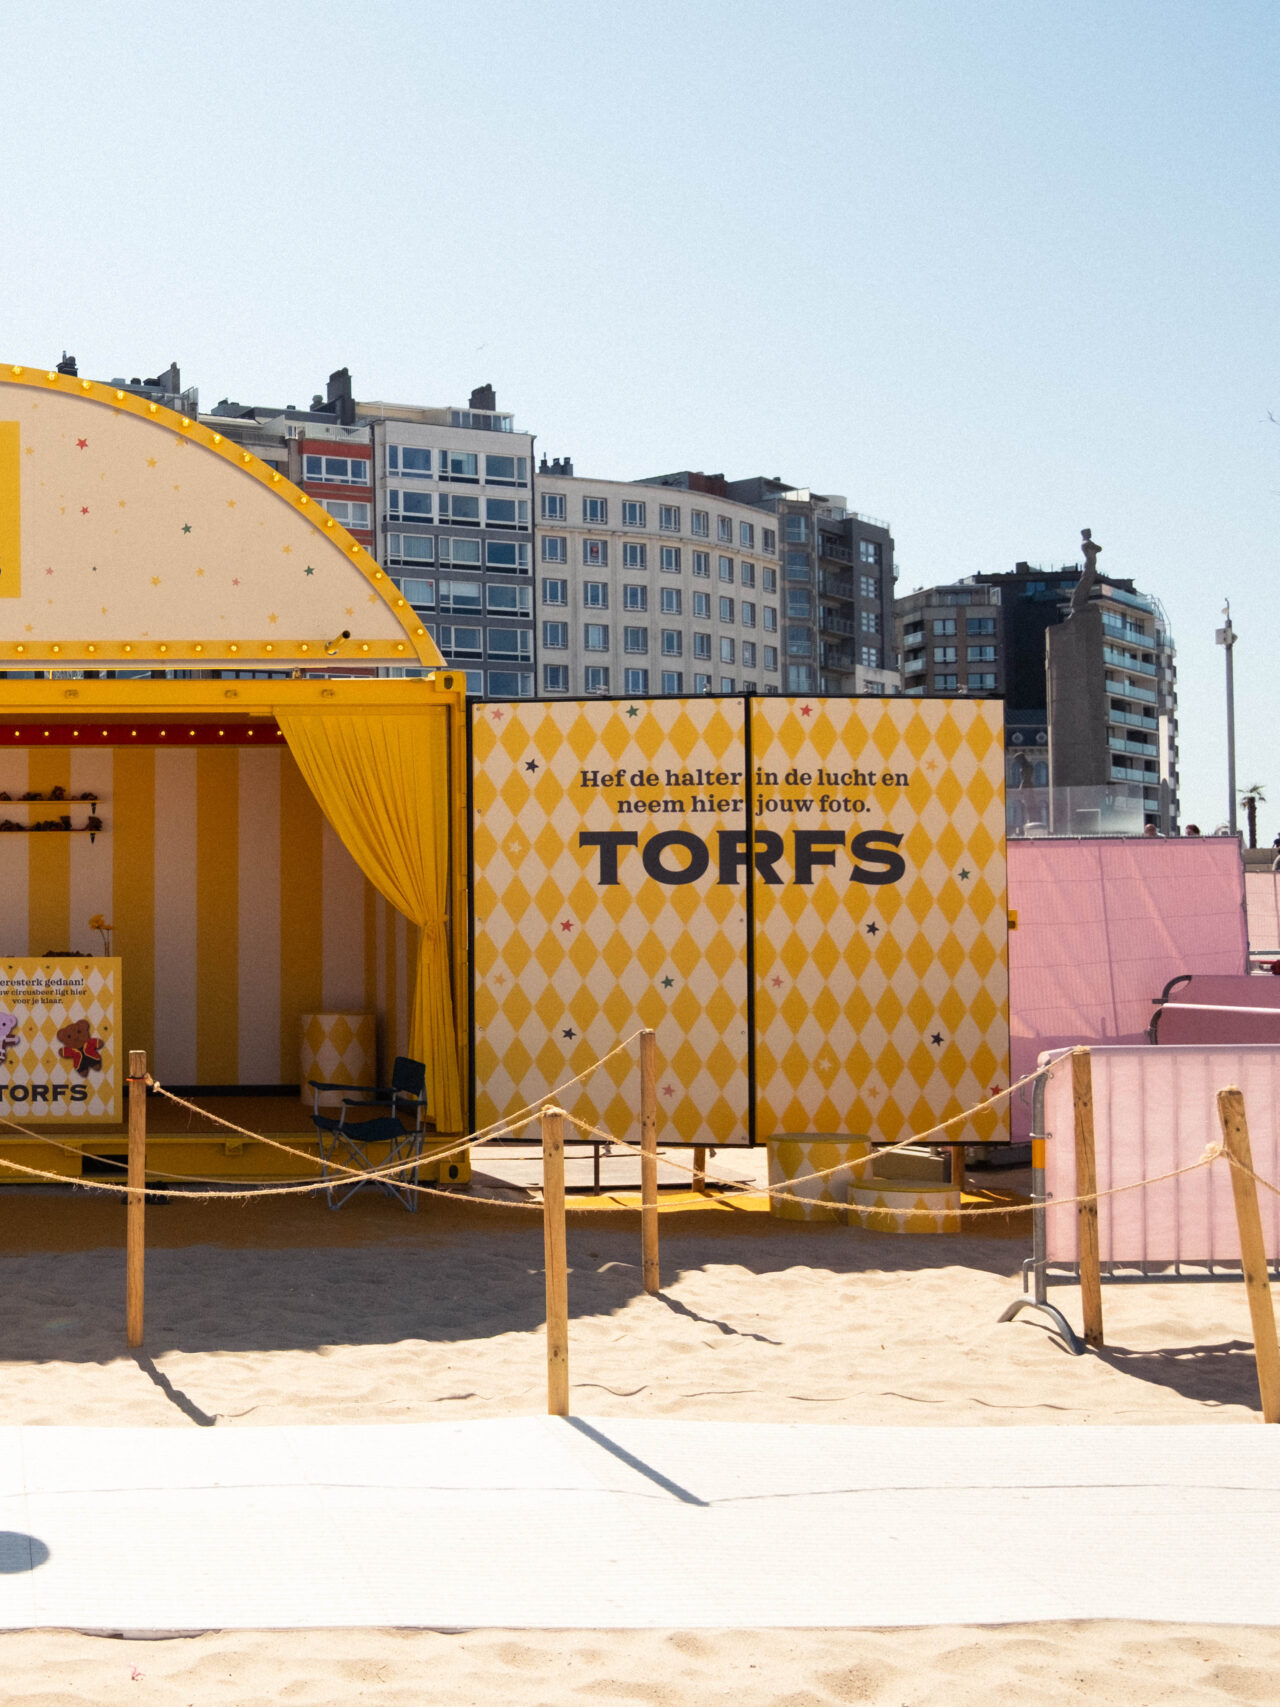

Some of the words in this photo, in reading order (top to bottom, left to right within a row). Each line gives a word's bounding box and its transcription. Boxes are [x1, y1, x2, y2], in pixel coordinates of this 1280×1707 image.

[580, 769, 626, 787] Hef
[630, 769, 659, 786] de
[665, 769, 742, 786] halter
[756, 767, 779, 786] in
[784, 768, 812, 786] de
[817, 768, 876, 786] lucht
[881, 771, 909, 786] en
[617, 799, 685, 813] neem
[691, 795, 743, 813] hier
[755, 794, 814, 816] jouw
[819, 794, 871, 813] foto.
[579, 829, 906, 885] TORFS
[44, 978, 84, 988] gedaan!
[11, 988, 54, 996] circusbeer
[55, 989, 69, 997] ligt
[32, 997, 40, 1005] je
